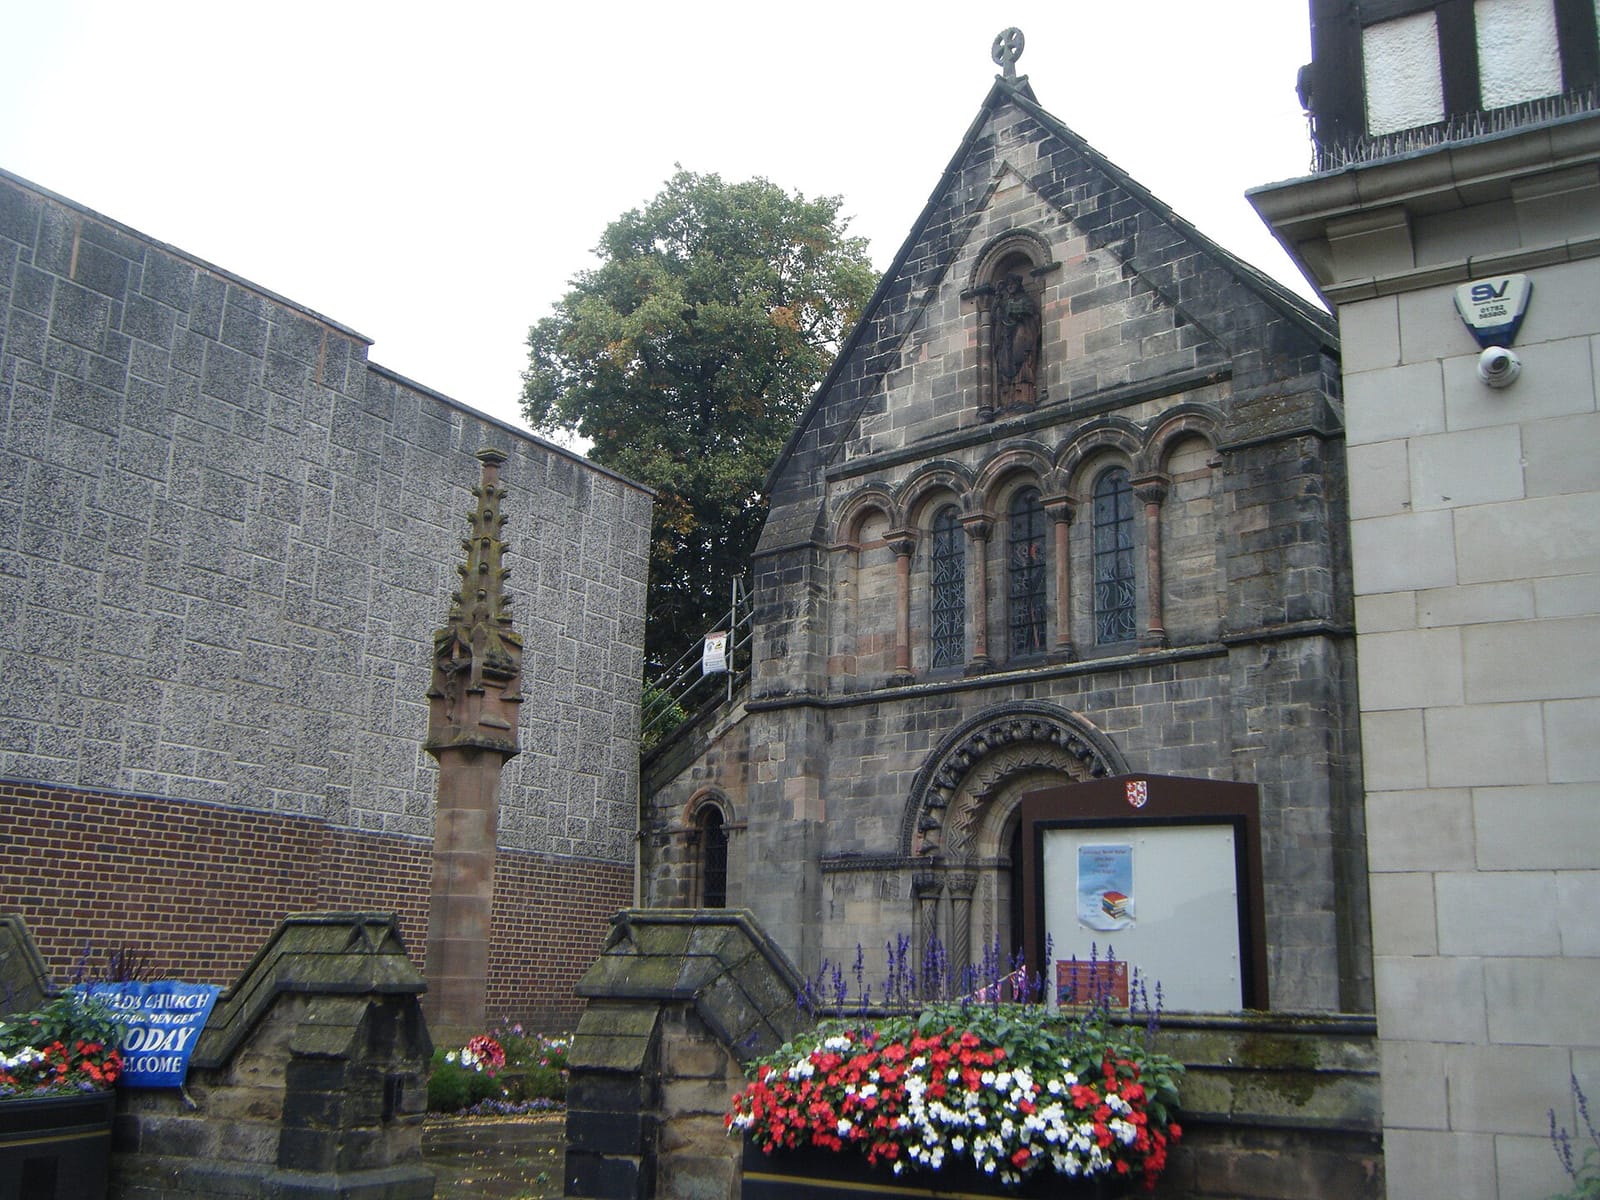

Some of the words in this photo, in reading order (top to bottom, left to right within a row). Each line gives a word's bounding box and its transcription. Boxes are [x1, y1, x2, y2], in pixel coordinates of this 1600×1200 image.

[144, 993, 210, 1009] CHURCH
[122, 1027, 196, 1052] ODAY
[122, 1056, 182, 1073] ELCOME
